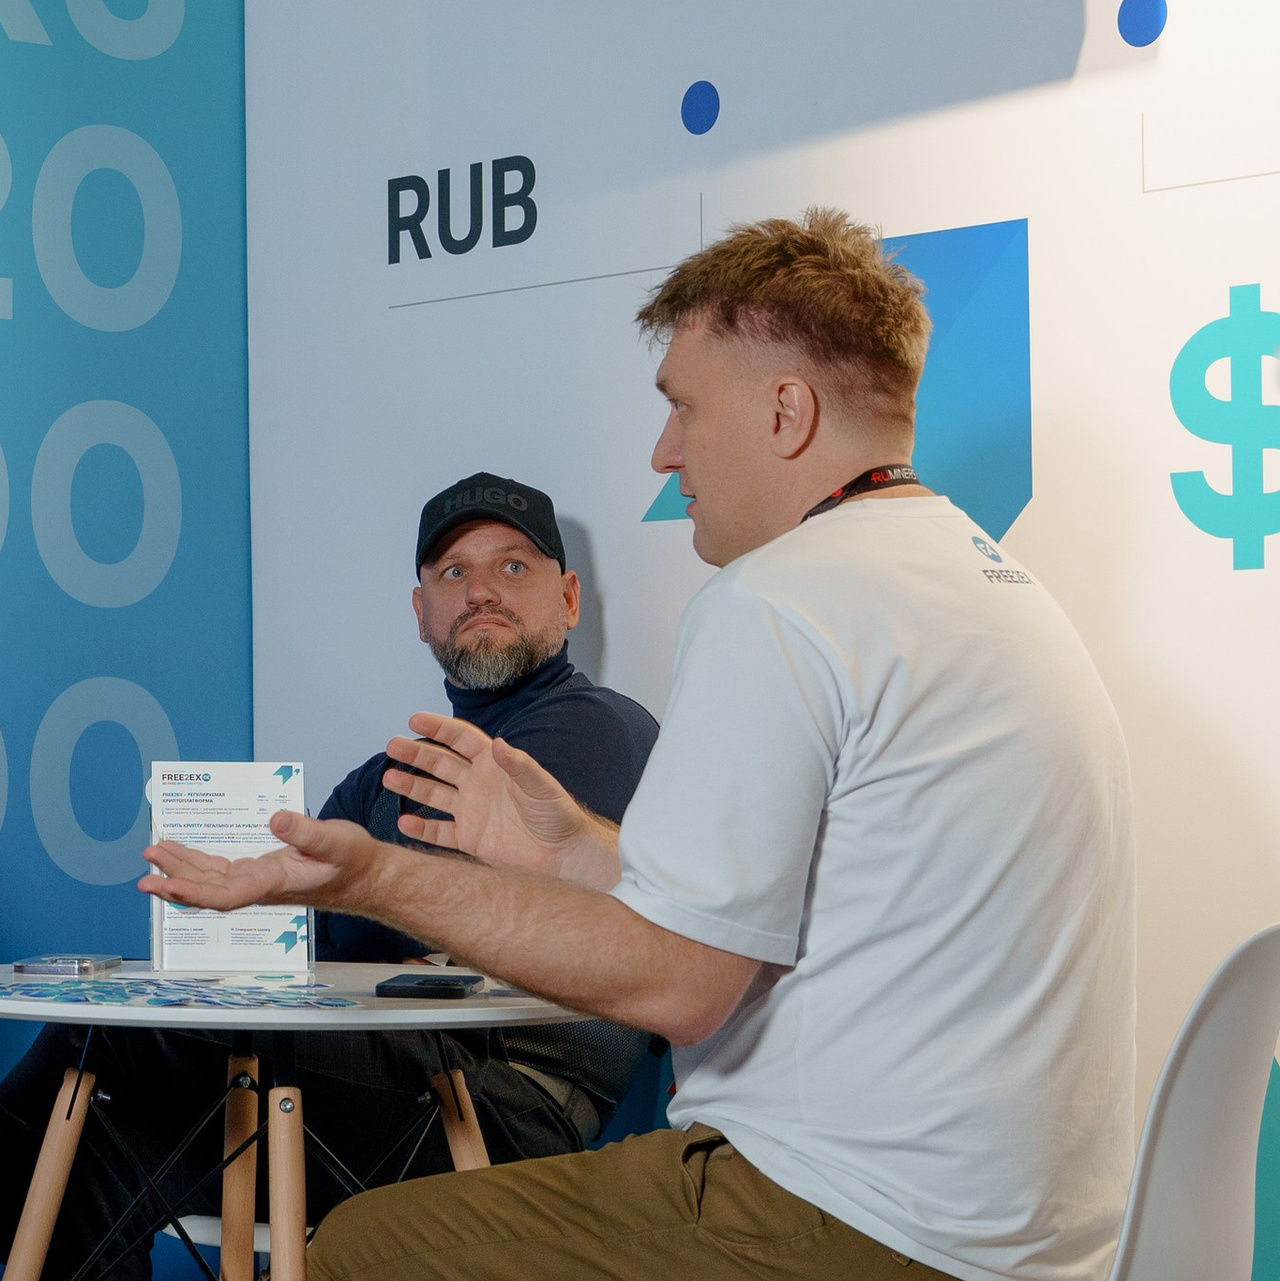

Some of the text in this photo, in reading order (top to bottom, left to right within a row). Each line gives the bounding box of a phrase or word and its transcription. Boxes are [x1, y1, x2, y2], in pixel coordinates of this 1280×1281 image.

[387, 153, 539, 265] RUB
[444, 486, 529, 515] HUGO
[162, 773, 202, 781] FREE2EX
